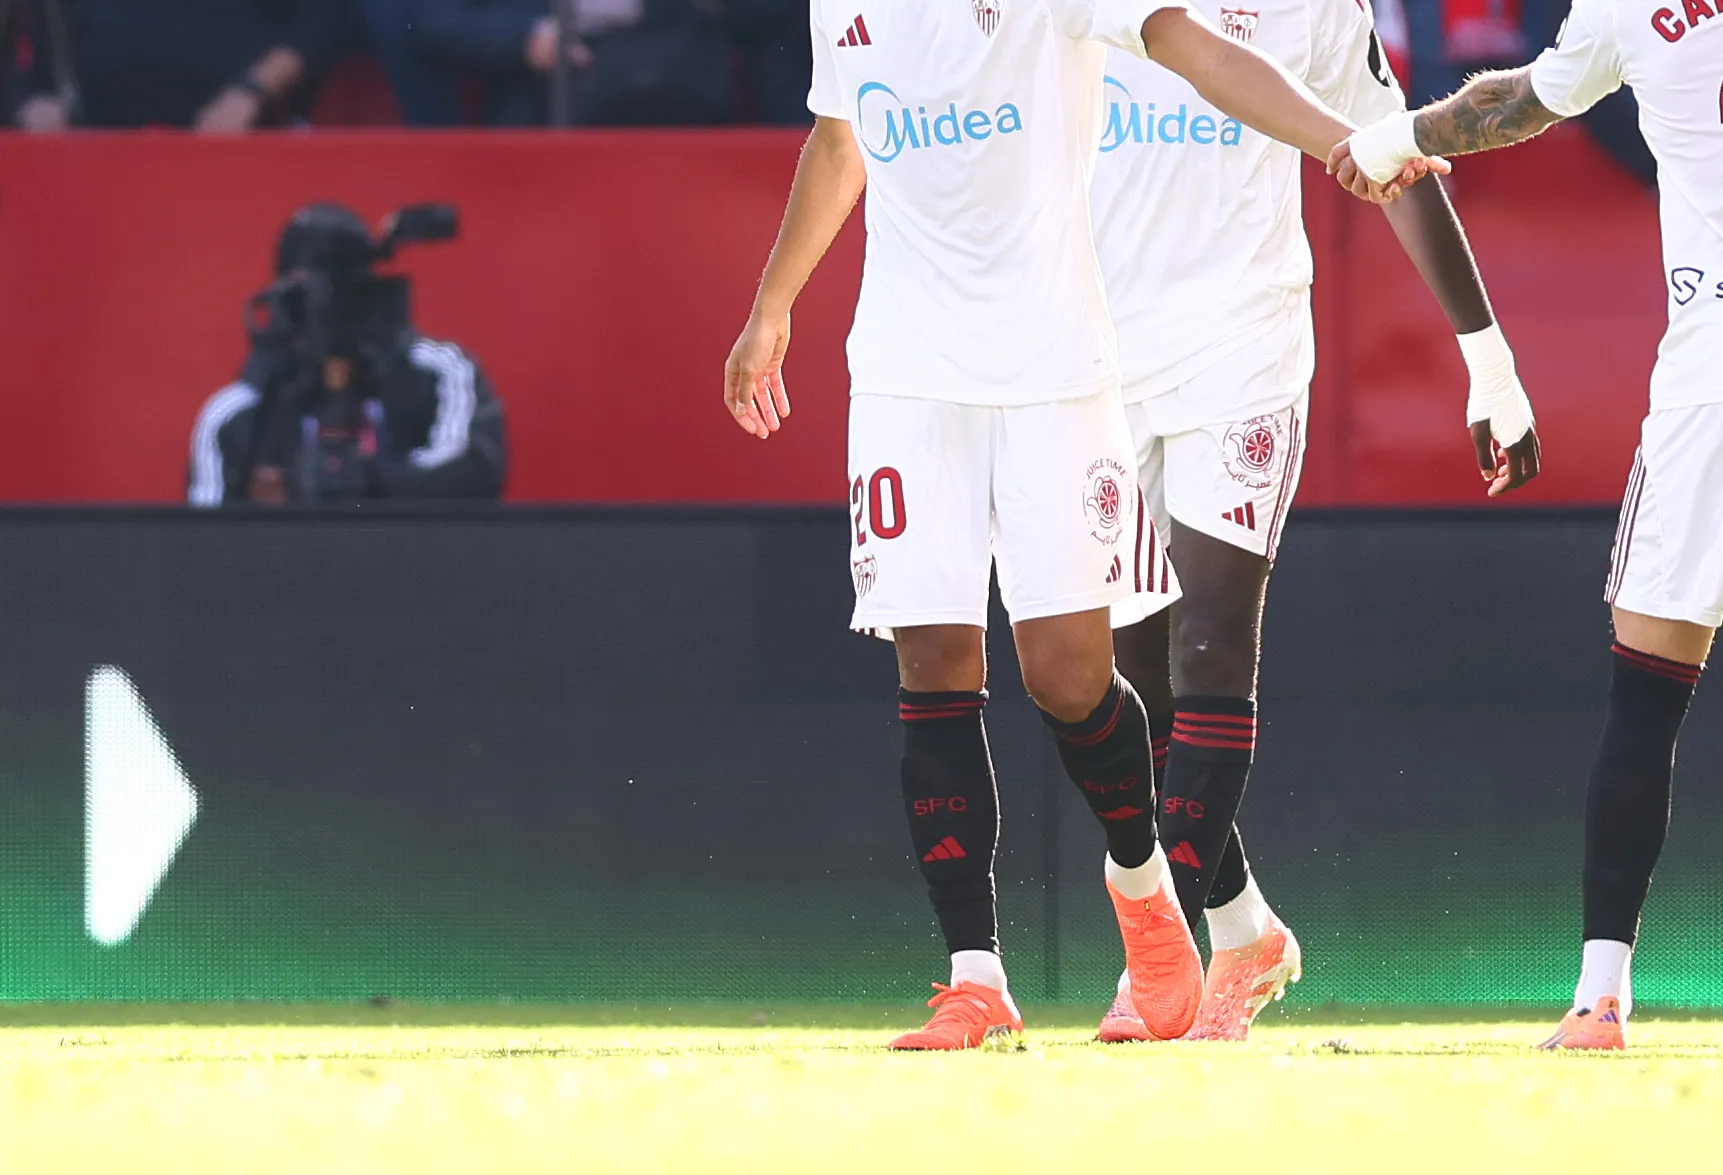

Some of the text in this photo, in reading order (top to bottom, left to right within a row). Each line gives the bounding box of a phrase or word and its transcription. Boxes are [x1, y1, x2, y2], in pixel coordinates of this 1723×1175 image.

[857, 81, 1023, 163] Midea
[1099, 75, 1242, 153] Midea
[1086, 458, 1127, 481] JUICE TIME
[853, 466, 907, 547] 20
[913, 796, 968, 816] SFC
[1164, 796, 1205, 819] SFC
